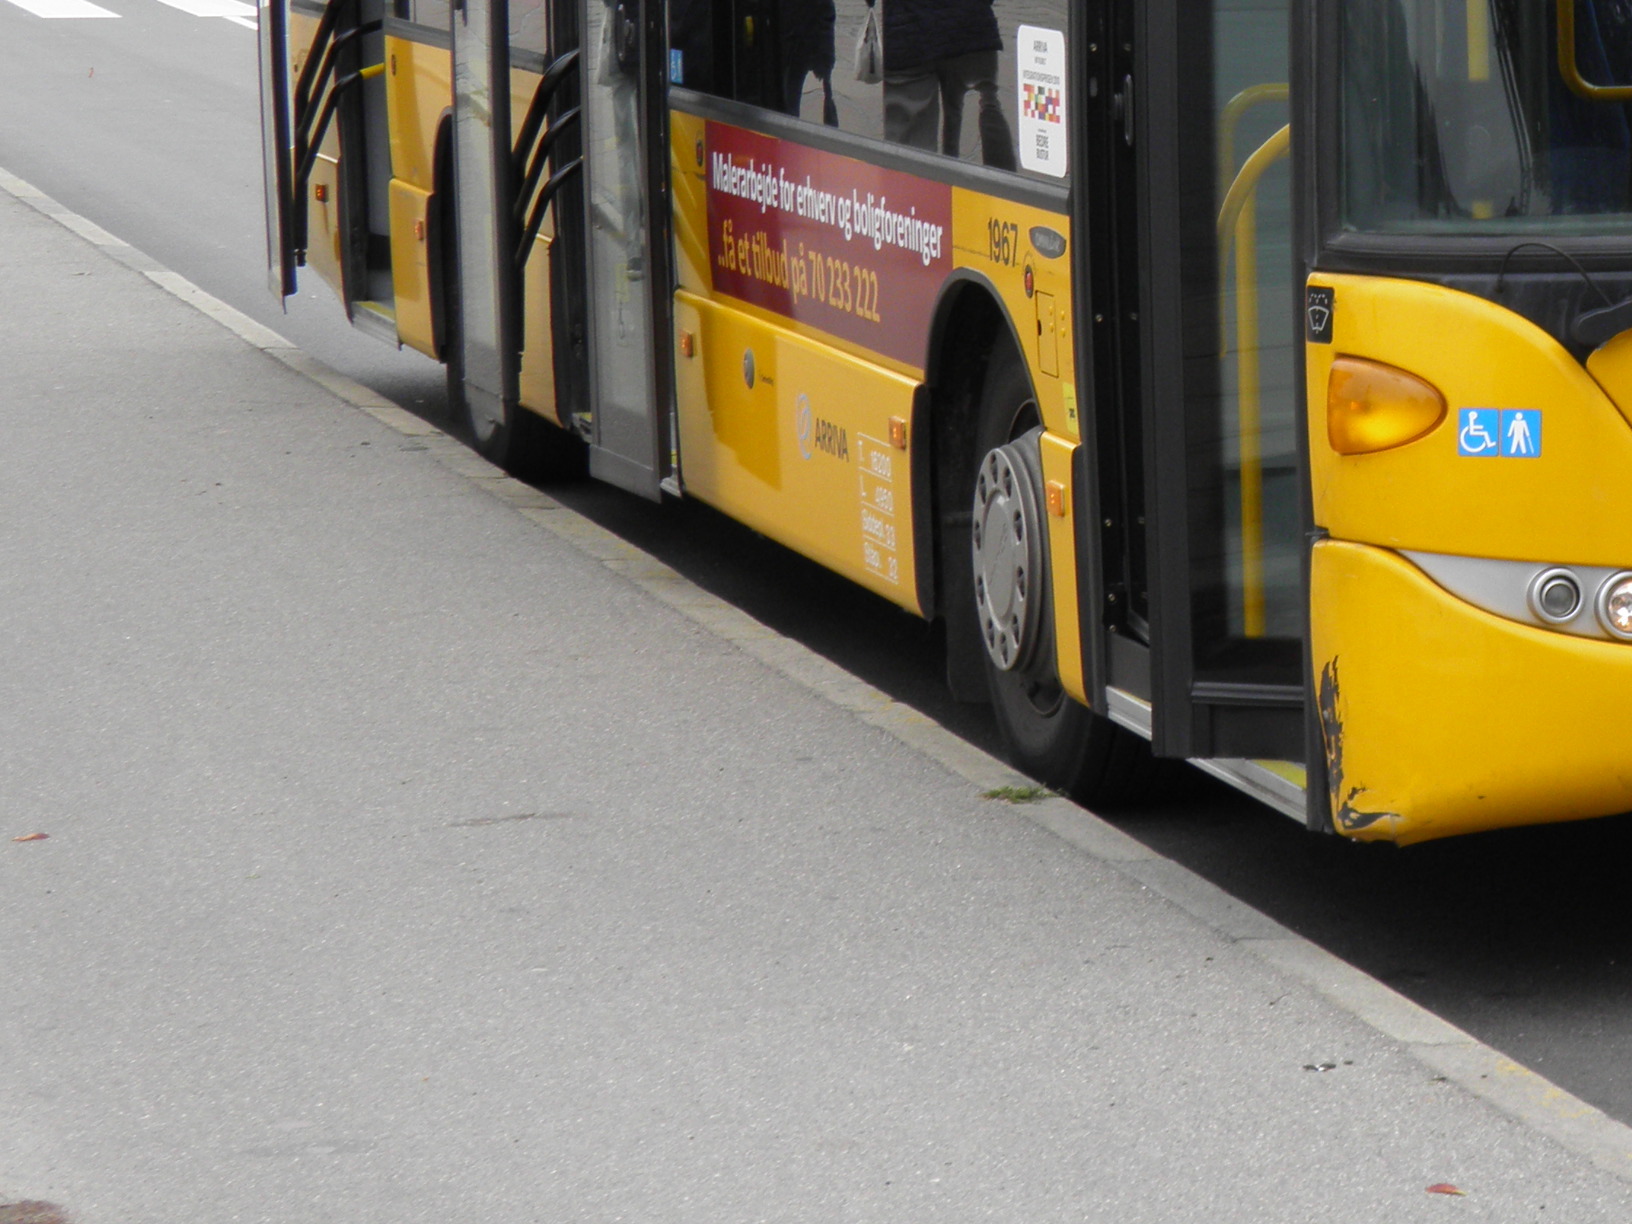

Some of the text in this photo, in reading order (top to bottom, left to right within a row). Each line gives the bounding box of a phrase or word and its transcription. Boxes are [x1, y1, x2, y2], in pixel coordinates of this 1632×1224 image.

[713, 151, 943, 266] Malerarbejde for erhverv og boligforeninger
[988, 217, 1018, 268] 1967
[737, 233, 751, 277] et
[752, 231, 789, 290] tilbud
[791, 242, 808, 304] på
[809, 250, 825, 302] 70
[827, 256, 851, 313] 233
[854, 265, 880, 323] 222
[815, 417, 849, 463] ARRIVA
